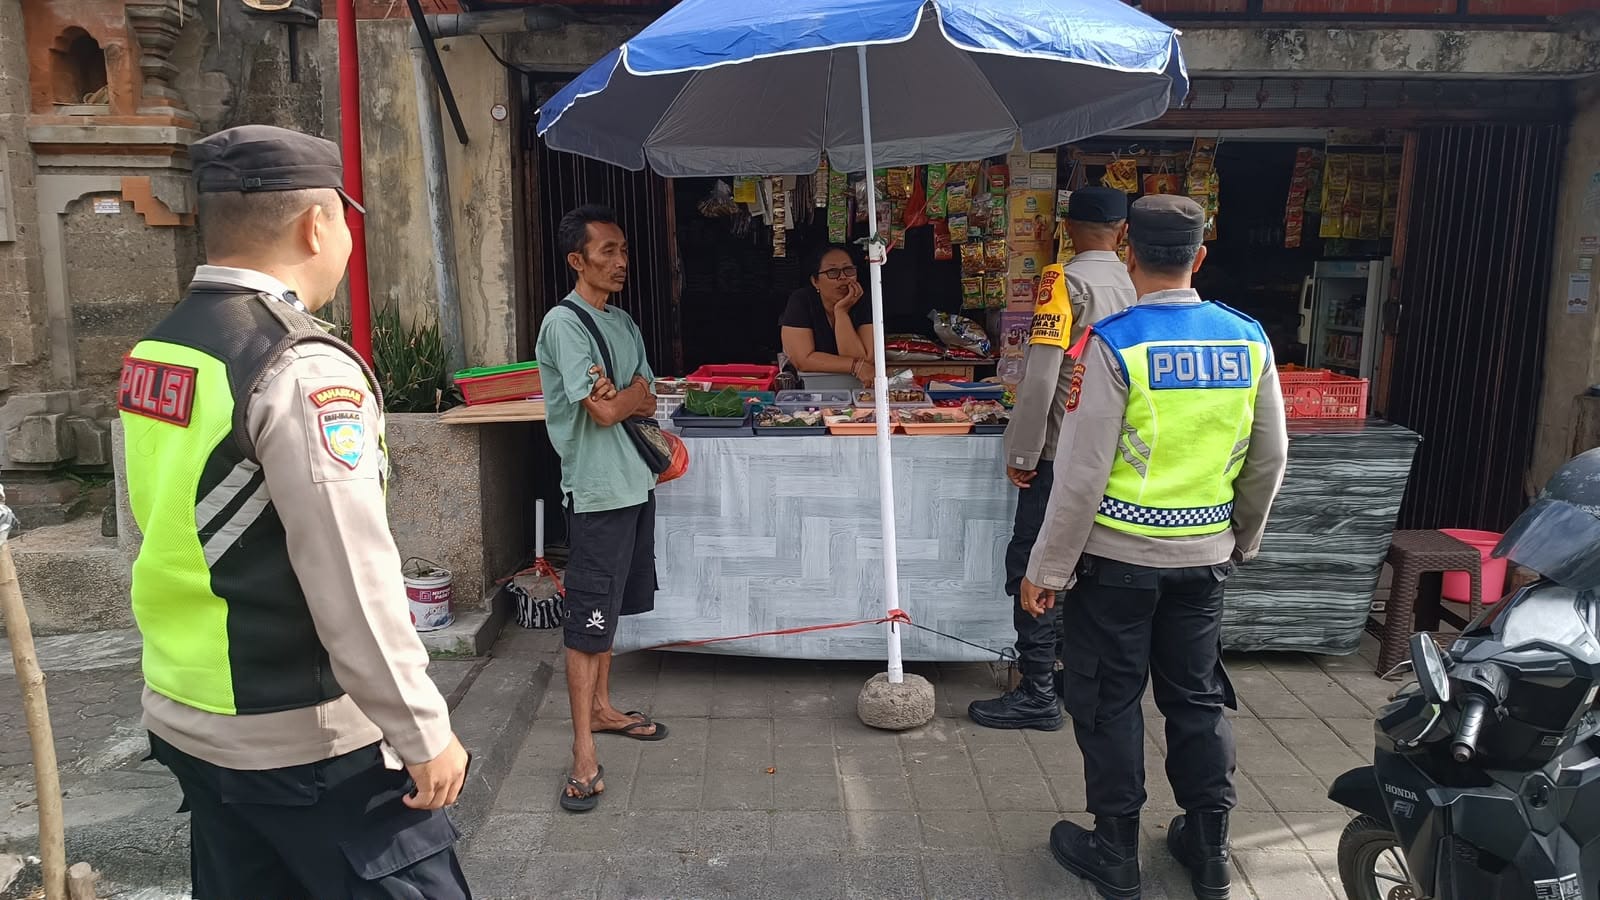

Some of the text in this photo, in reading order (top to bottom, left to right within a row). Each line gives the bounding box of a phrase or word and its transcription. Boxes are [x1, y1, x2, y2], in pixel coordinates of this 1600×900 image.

[1153, 352, 1249, 382] POLISI
[120, 364, 190, 419] POLISI
[1385, 783, 1420, 802] HONDA
